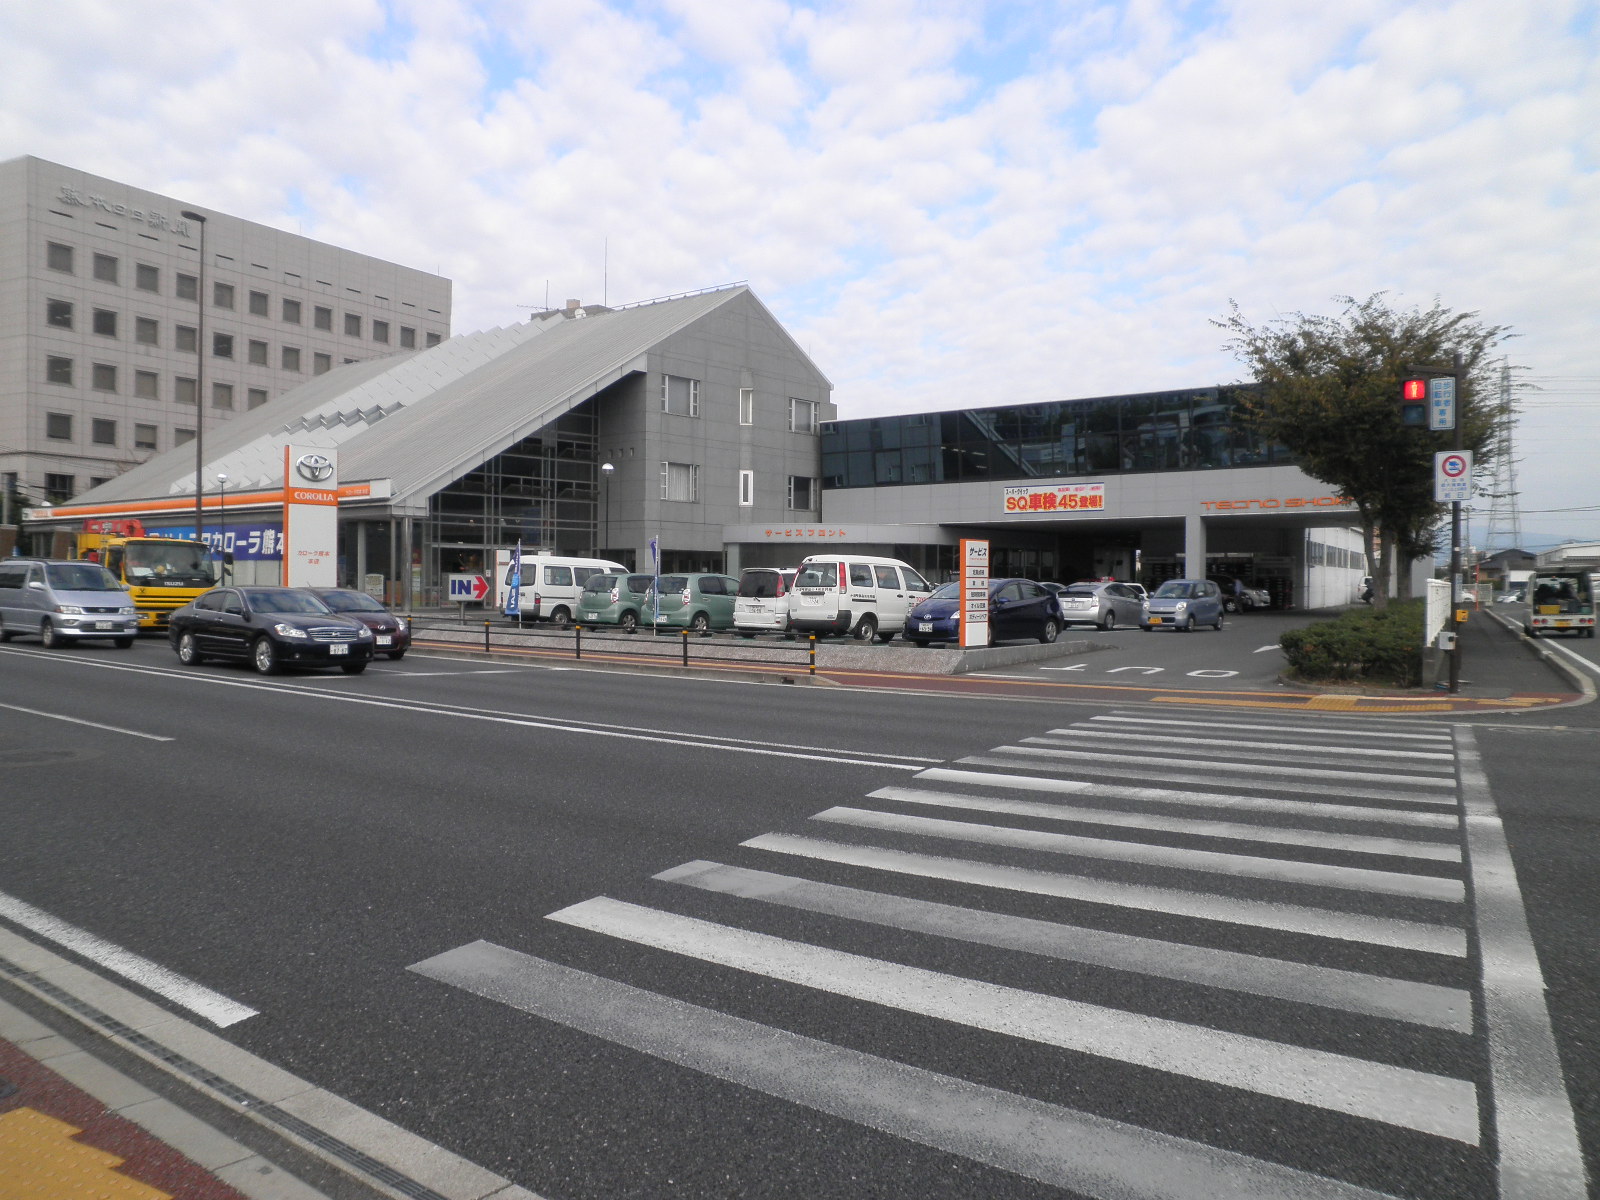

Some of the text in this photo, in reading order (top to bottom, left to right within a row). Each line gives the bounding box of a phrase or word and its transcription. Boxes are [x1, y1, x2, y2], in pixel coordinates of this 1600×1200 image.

[294, 491, 334, 501] COROLLA
[765, 528, 846, 537] サービスフロント
[969, 547, 987, 556] サービス
[451, 579, 472, 595] IN
